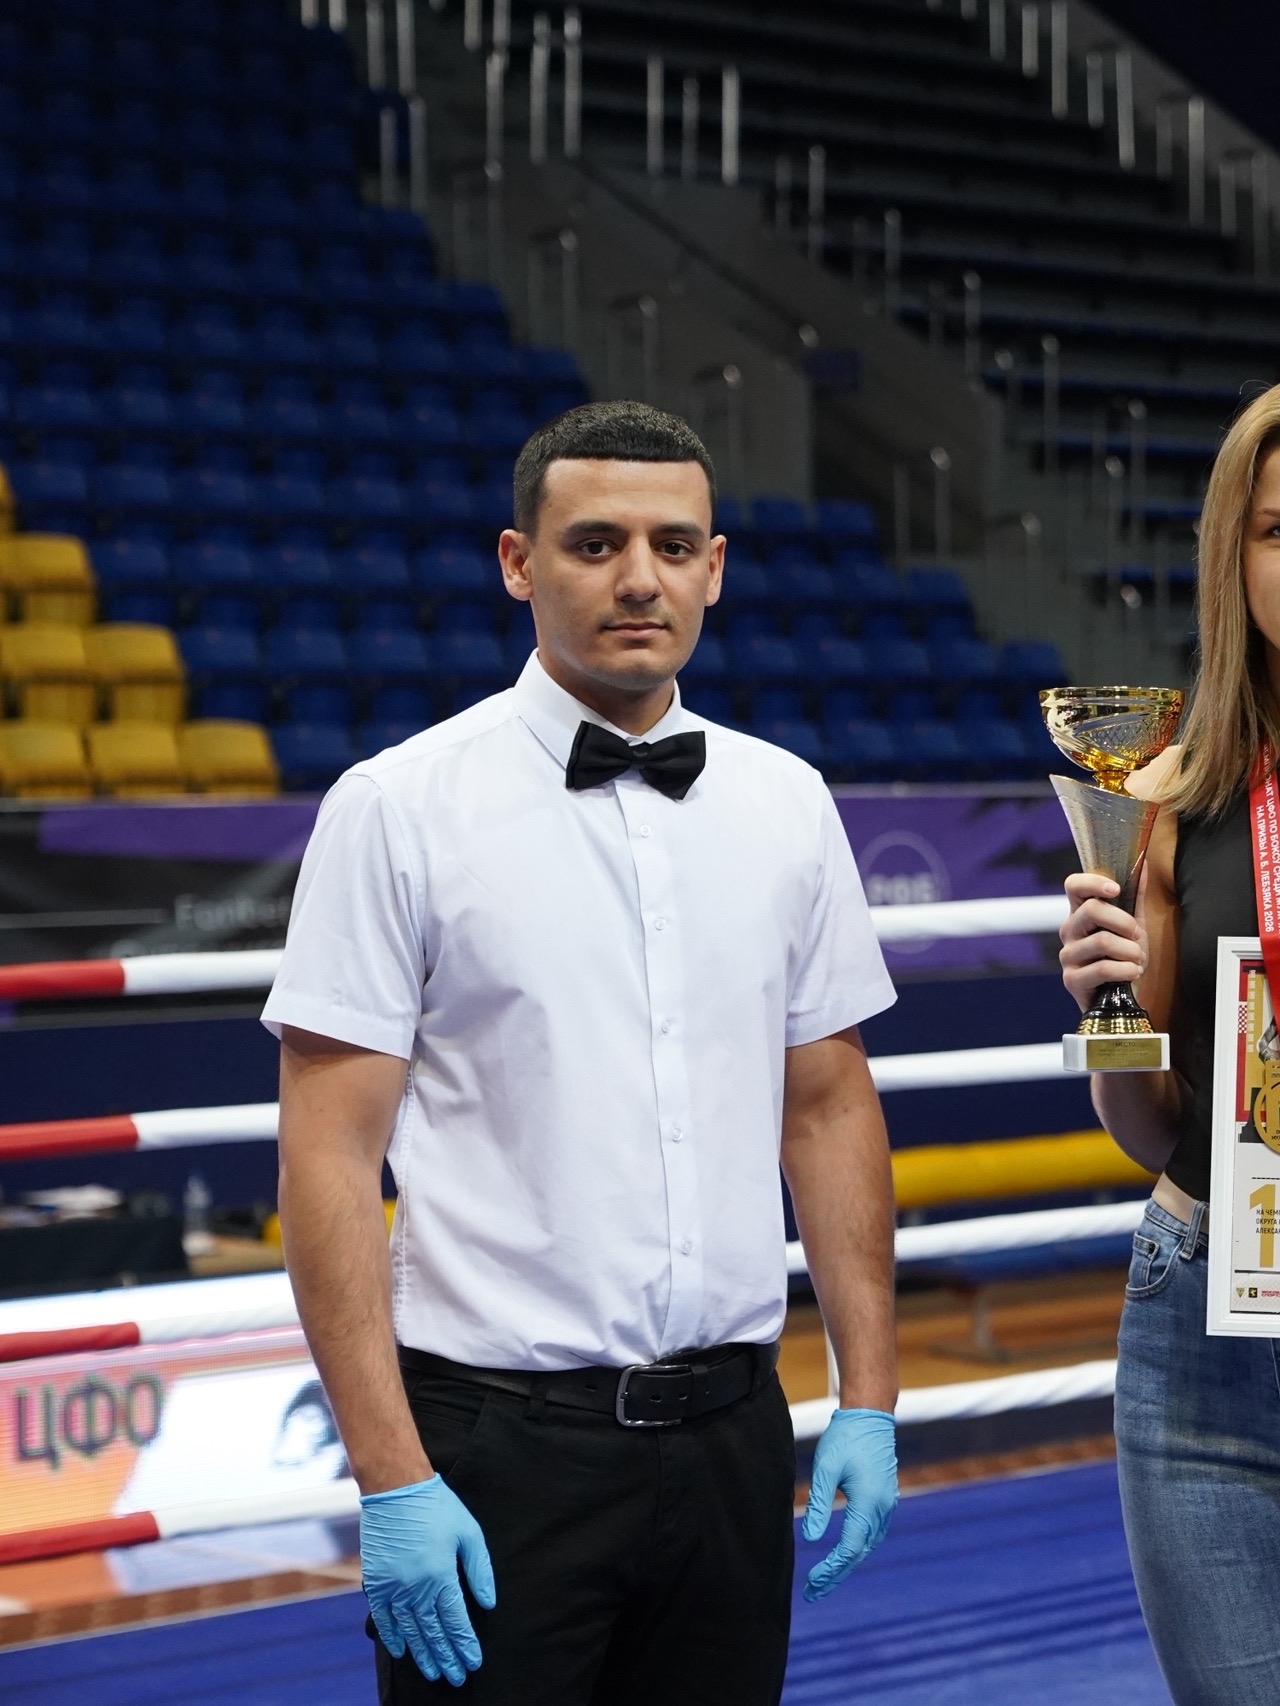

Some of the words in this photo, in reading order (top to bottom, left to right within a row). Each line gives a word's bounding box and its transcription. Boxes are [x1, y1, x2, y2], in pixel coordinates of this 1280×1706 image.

[1256, 805, 1265, 820] НА
[1266, 797, 1276, 820] ЦФО
[1257, 820, 1268, 850] ПРИЗЫ
[1269, 820, 1278, 834] ПО
[1260, 861, 1269, 870] Б.
[1261, 870, 1272, 910] ЛЕБЗЯКА
[1264, 911, 1274, 932] 2026
[1249, 1184, 1276, 1268] 1
[16, 1375, 162, 1470] ЦФО
